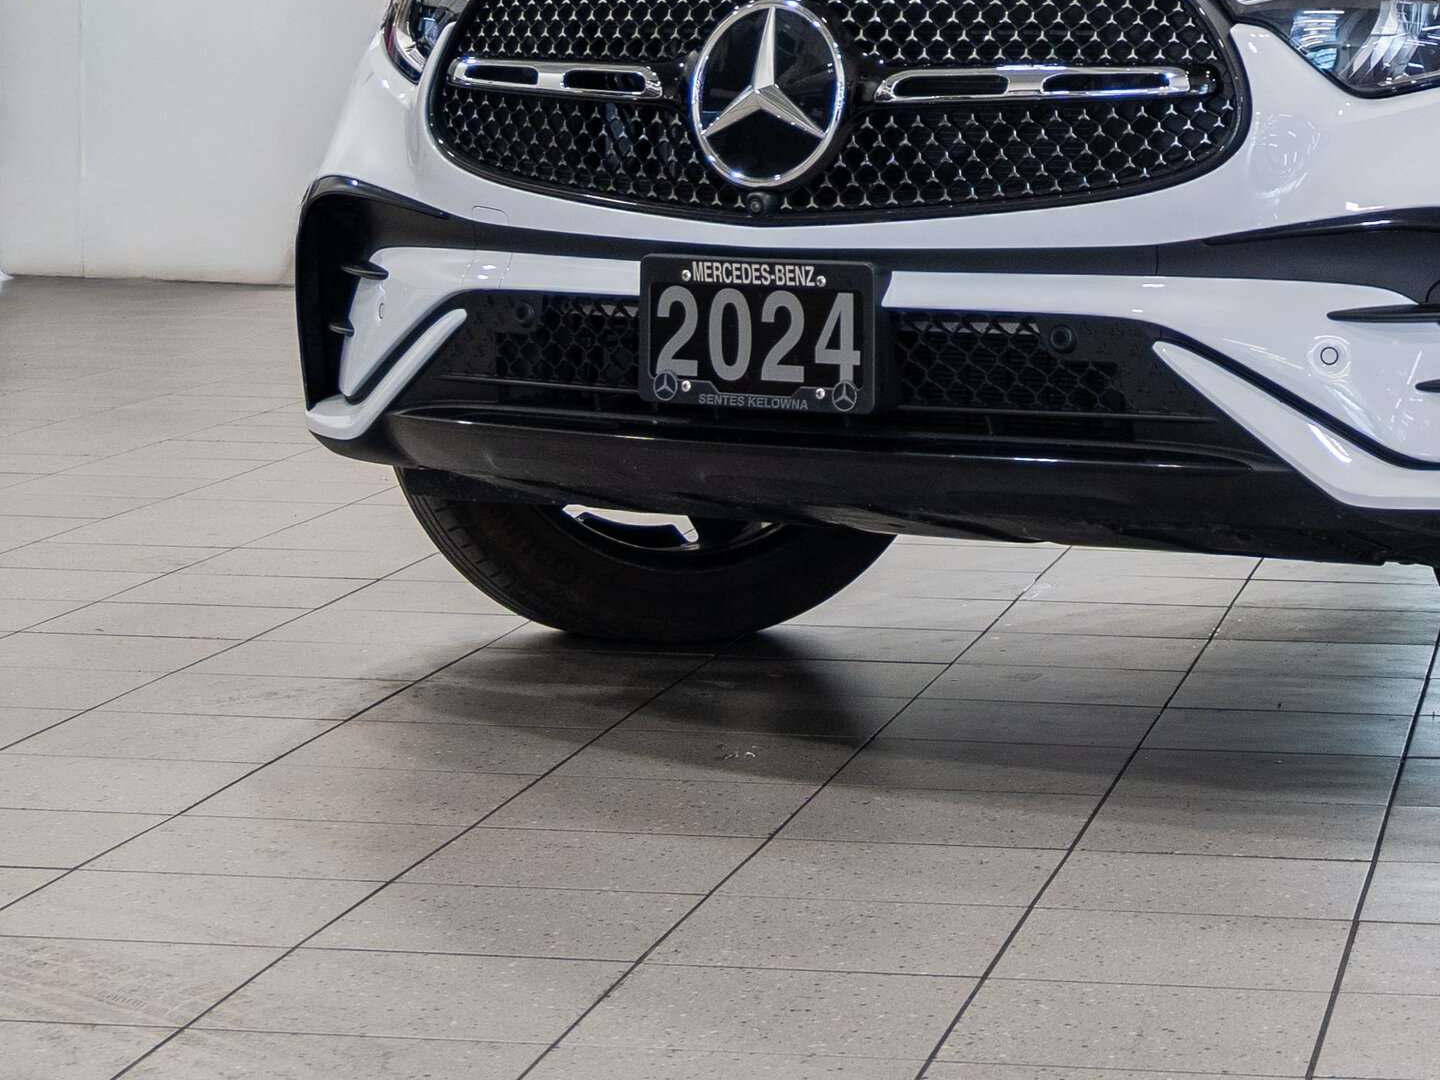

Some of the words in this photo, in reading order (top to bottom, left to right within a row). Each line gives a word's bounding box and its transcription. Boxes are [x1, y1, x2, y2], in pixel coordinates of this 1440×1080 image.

[692, 261, 816, 287] MERCEDES-BENZ
[655, 285, 862, 384] 2024
[698, 393, 745, 407] SENTES
[747, 395, 809, 411] KELOWNA
